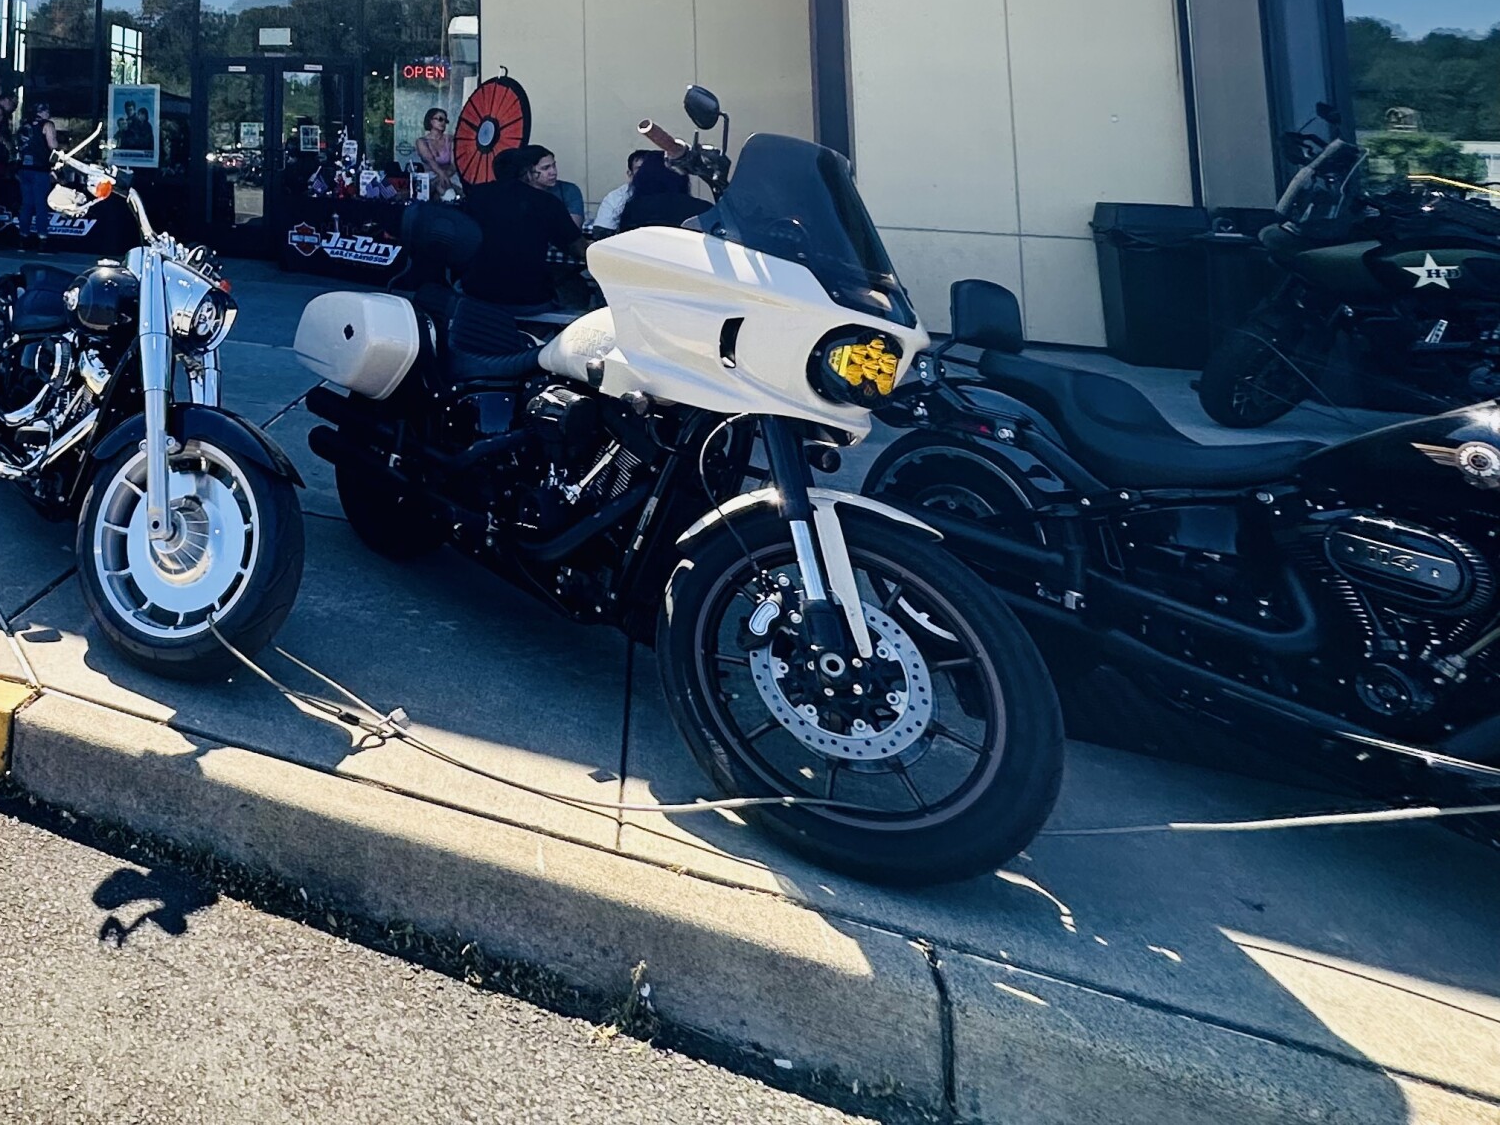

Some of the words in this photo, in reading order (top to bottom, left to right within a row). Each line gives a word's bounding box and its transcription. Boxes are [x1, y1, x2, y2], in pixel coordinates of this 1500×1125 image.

[403, 65, 445, 79] OPEN
[1425, 268, 1462, 279] H-D
[1366, 545, 1420, 572] 114
